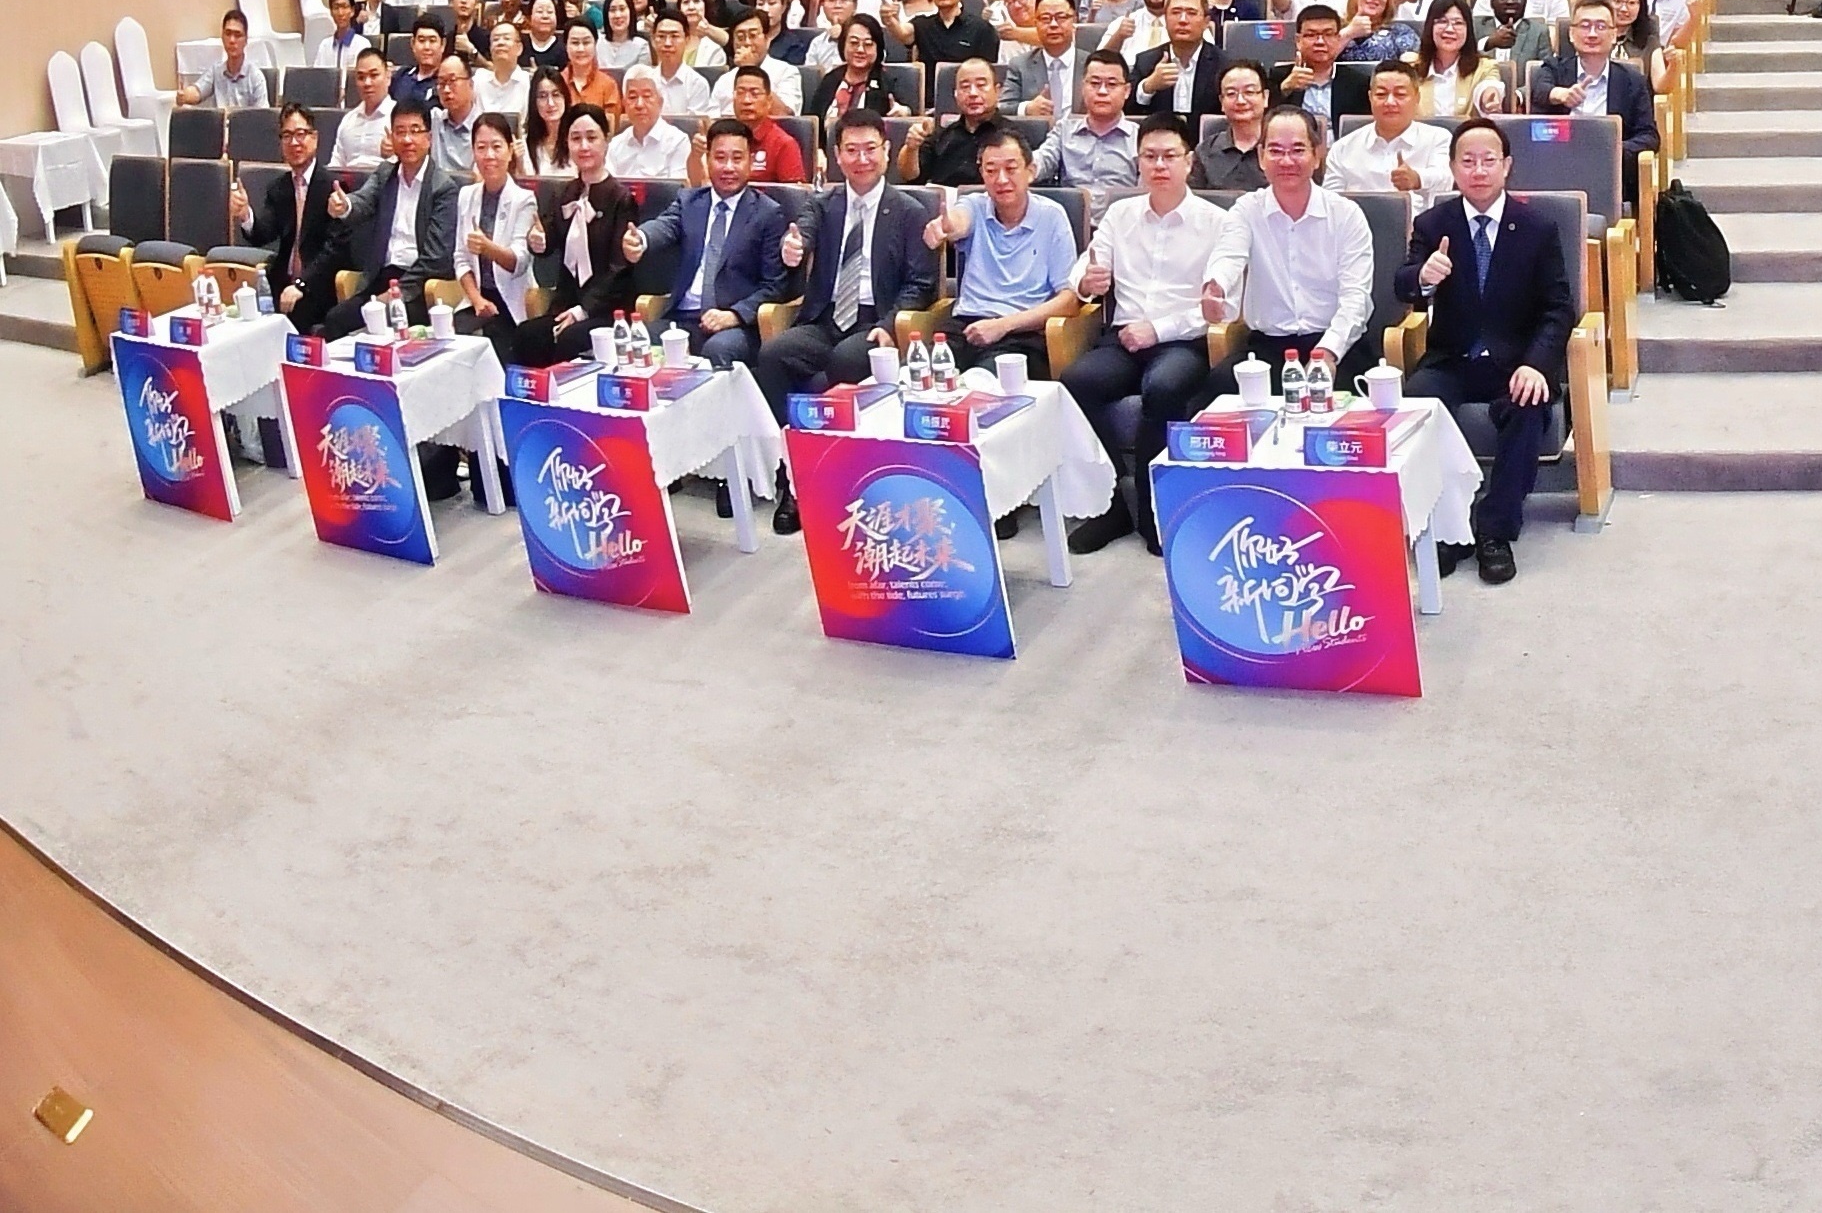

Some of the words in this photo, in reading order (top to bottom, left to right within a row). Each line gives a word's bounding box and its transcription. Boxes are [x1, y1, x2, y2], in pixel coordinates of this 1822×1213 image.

[584, 529, 648, 561] Hello
[906, 590, 938, 599] futures
[1271, 605, 1376, 648] Hello
